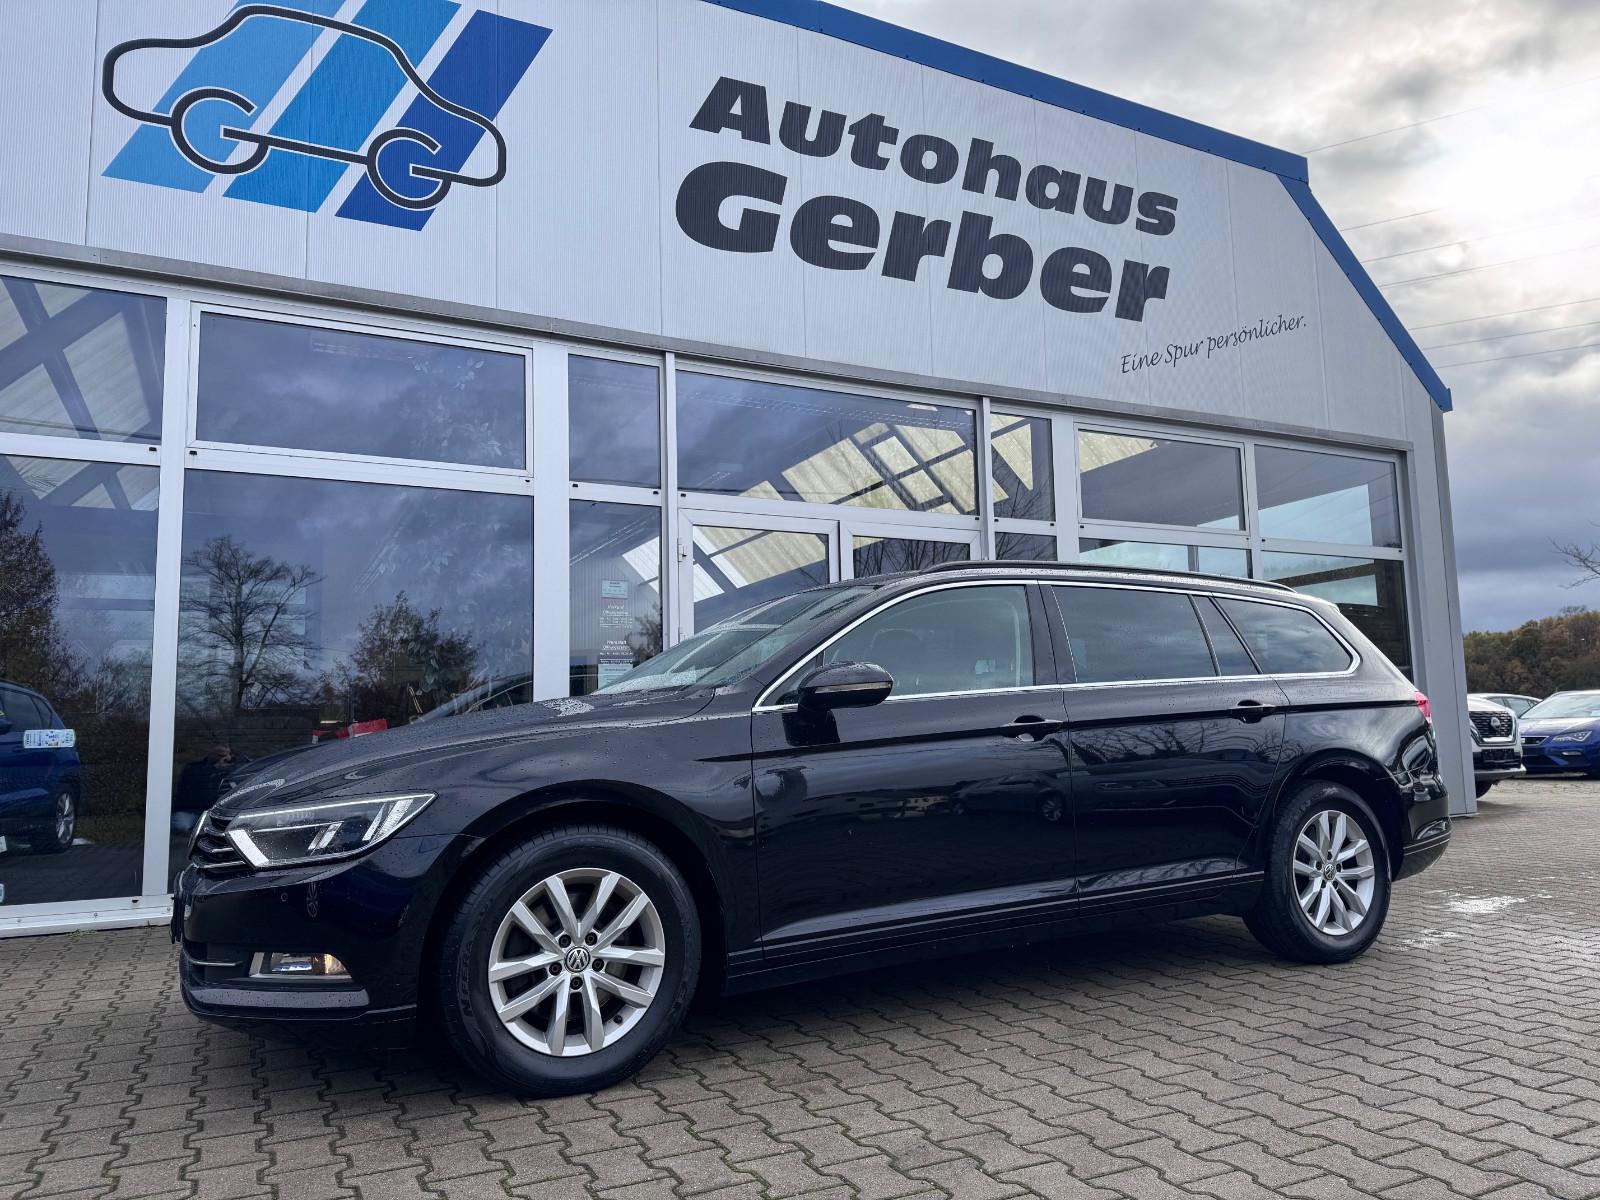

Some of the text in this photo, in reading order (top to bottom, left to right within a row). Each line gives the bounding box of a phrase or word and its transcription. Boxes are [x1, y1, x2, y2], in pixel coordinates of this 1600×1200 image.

[689, 76, 1179, 236] Autohaus
[675, 161, 1170, 322] Gerber
[1121, 314, 1307, 374] Eine Spur persönlicher.
